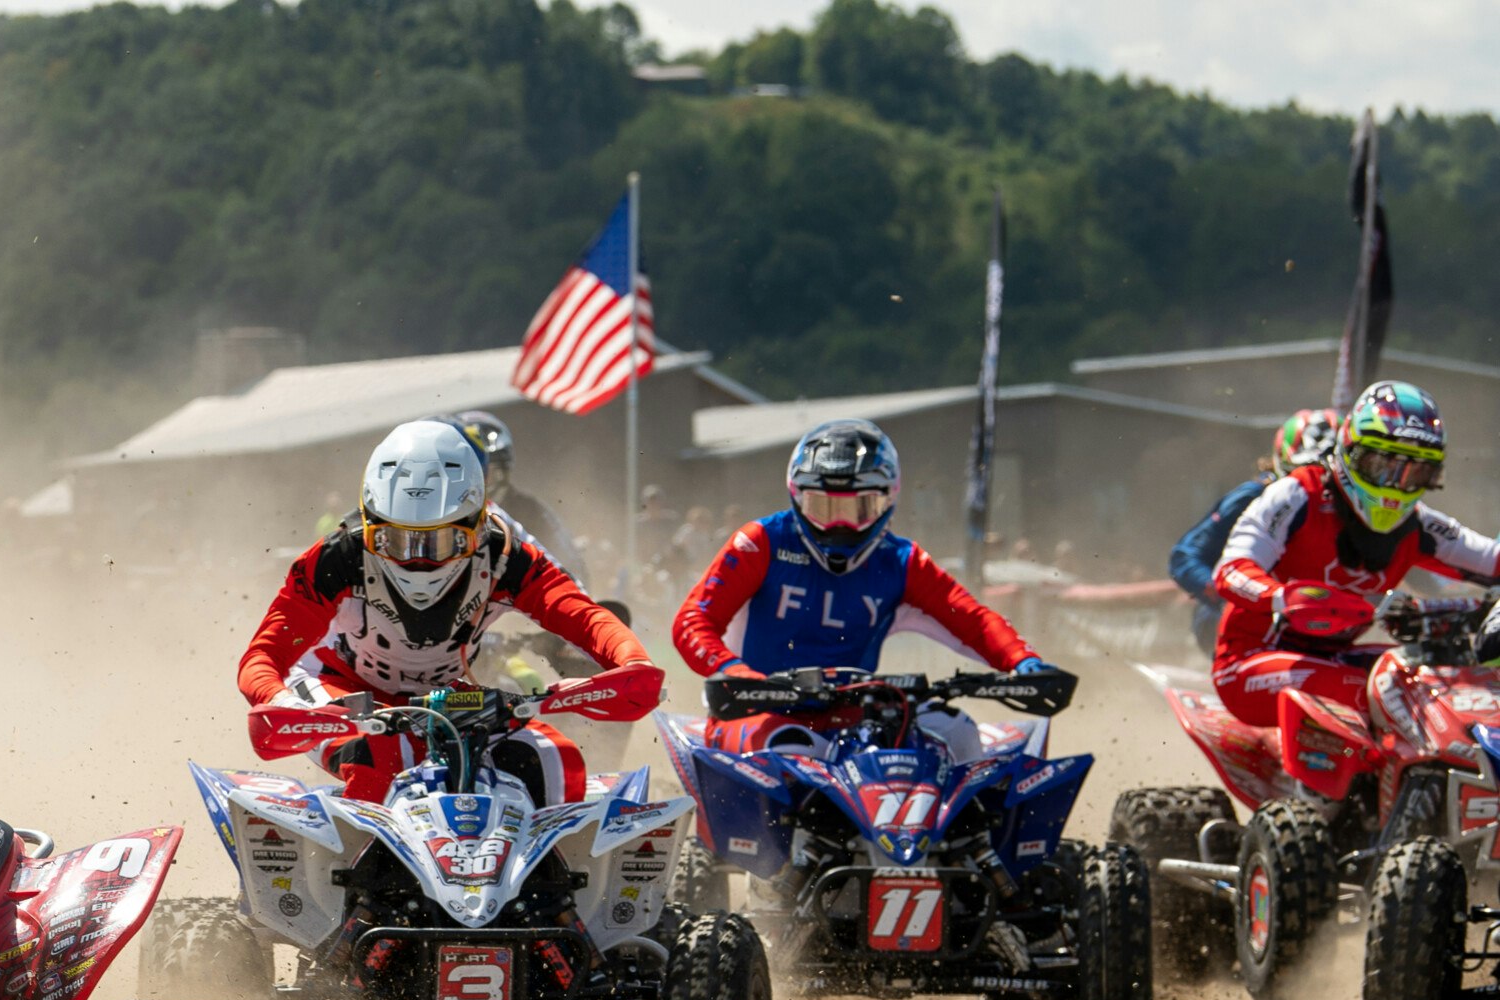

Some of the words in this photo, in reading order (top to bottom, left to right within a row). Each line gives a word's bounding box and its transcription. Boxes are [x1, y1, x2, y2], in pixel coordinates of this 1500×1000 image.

[371, 598, 402, 625] LEATT
[454, 591, 482, 627] LEATT
[776, 583, 883, 630] FLY
[548, 687, 618, 710] ACERBIS
[735, 689, 799, 702] ACERBIS
[975, 686, 1039, 696] ACERBIS
[1452, 687, 1500, 712] 52
[276, 722, 349, 735] ACERBIS
[872, 791, 938, 827] 11
[81, 837, 151, 879] 9
[450, 854, 498, 875] 30
[872, 888, 942, 936] 11
[972, 975, 1050, 990] HOUSER
